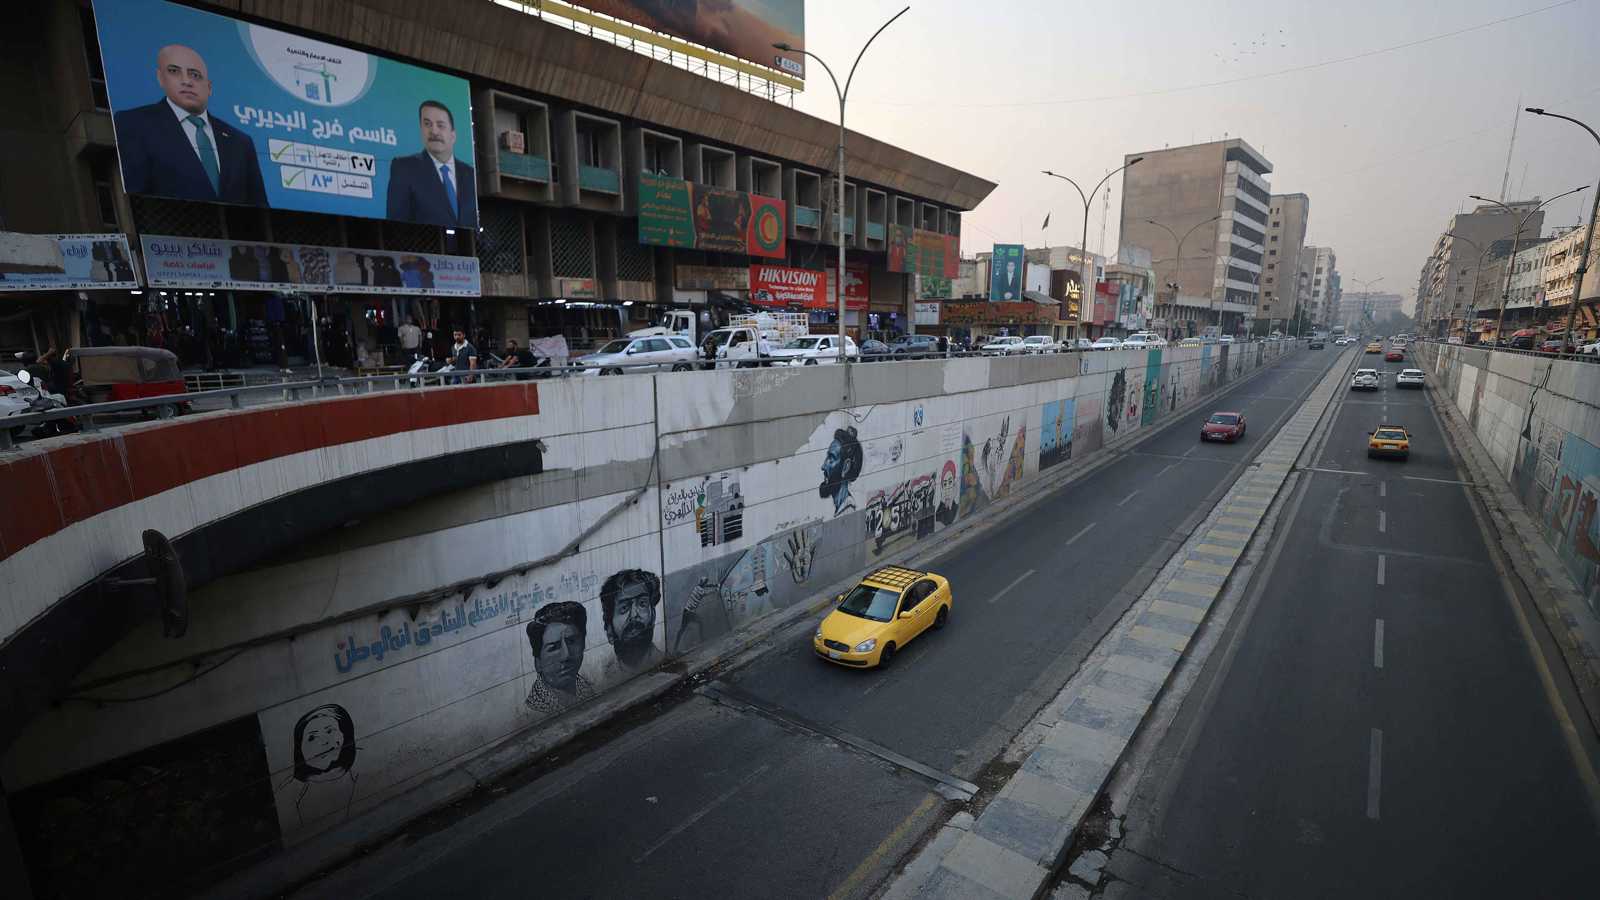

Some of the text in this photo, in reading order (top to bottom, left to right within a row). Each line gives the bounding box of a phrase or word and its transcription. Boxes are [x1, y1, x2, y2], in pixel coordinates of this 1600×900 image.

[233, 104, 397, 146] قاسم فرج البديري
[350, 155, 373, 171] ٢٠٧
[311, 174, 333, 188] ٨٣
[758, 267, 818, 287] HIKVISION
[413, 604, 467, 647] البنادق
